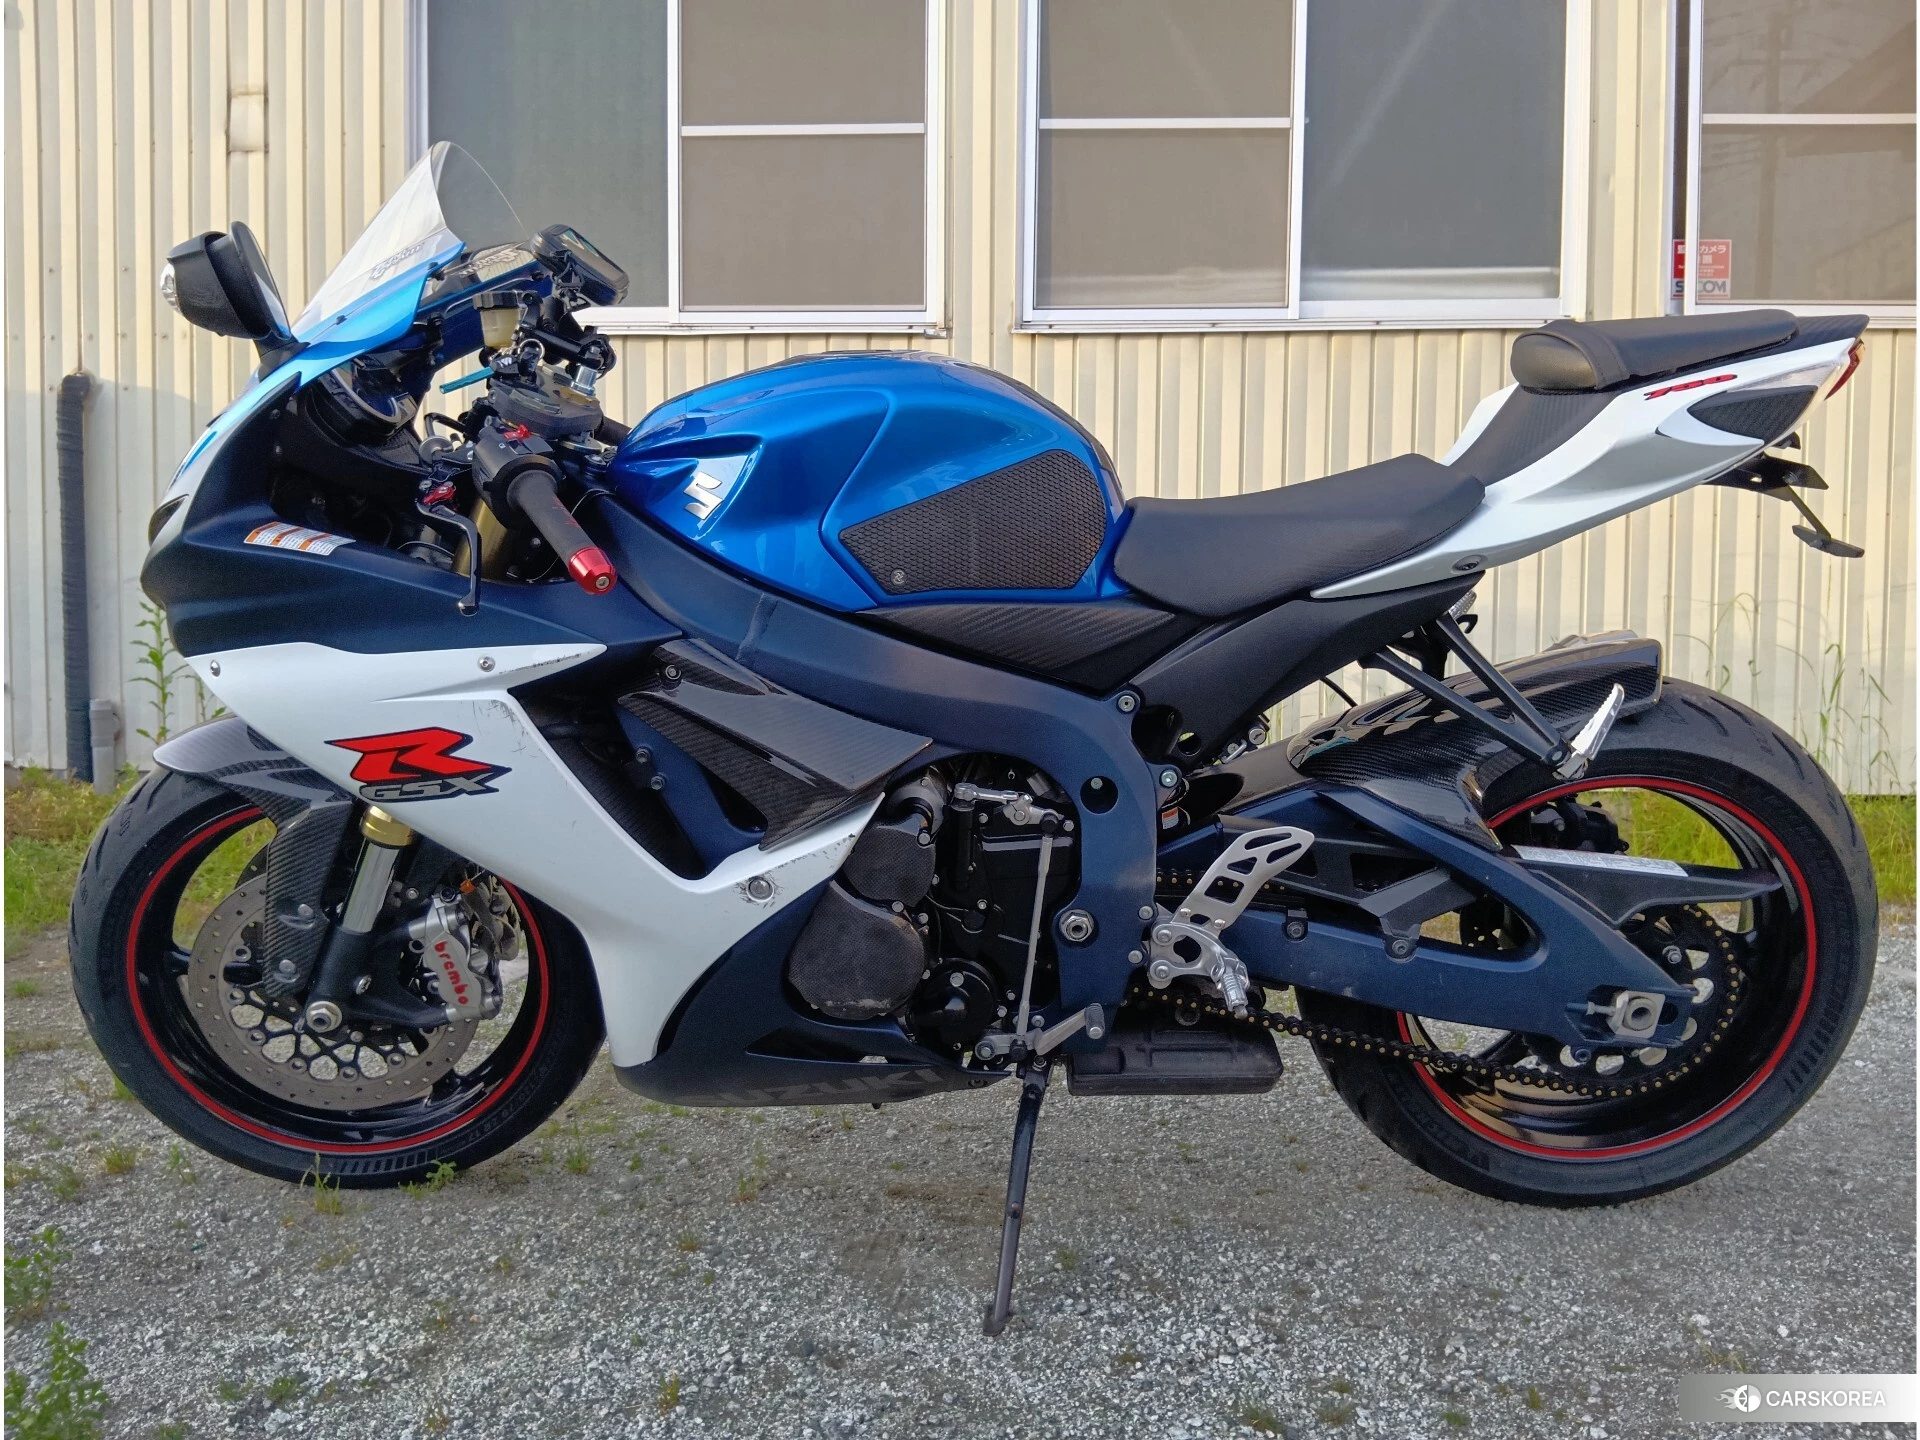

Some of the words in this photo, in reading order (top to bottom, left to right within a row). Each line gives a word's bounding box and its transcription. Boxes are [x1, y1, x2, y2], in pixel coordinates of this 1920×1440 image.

[1675, 280, 1727, 293] SCOM
[325, 727, 508, 784] R
[359, 772, 498, 803] GSX
[434, 940, 469, 1005] brembo
